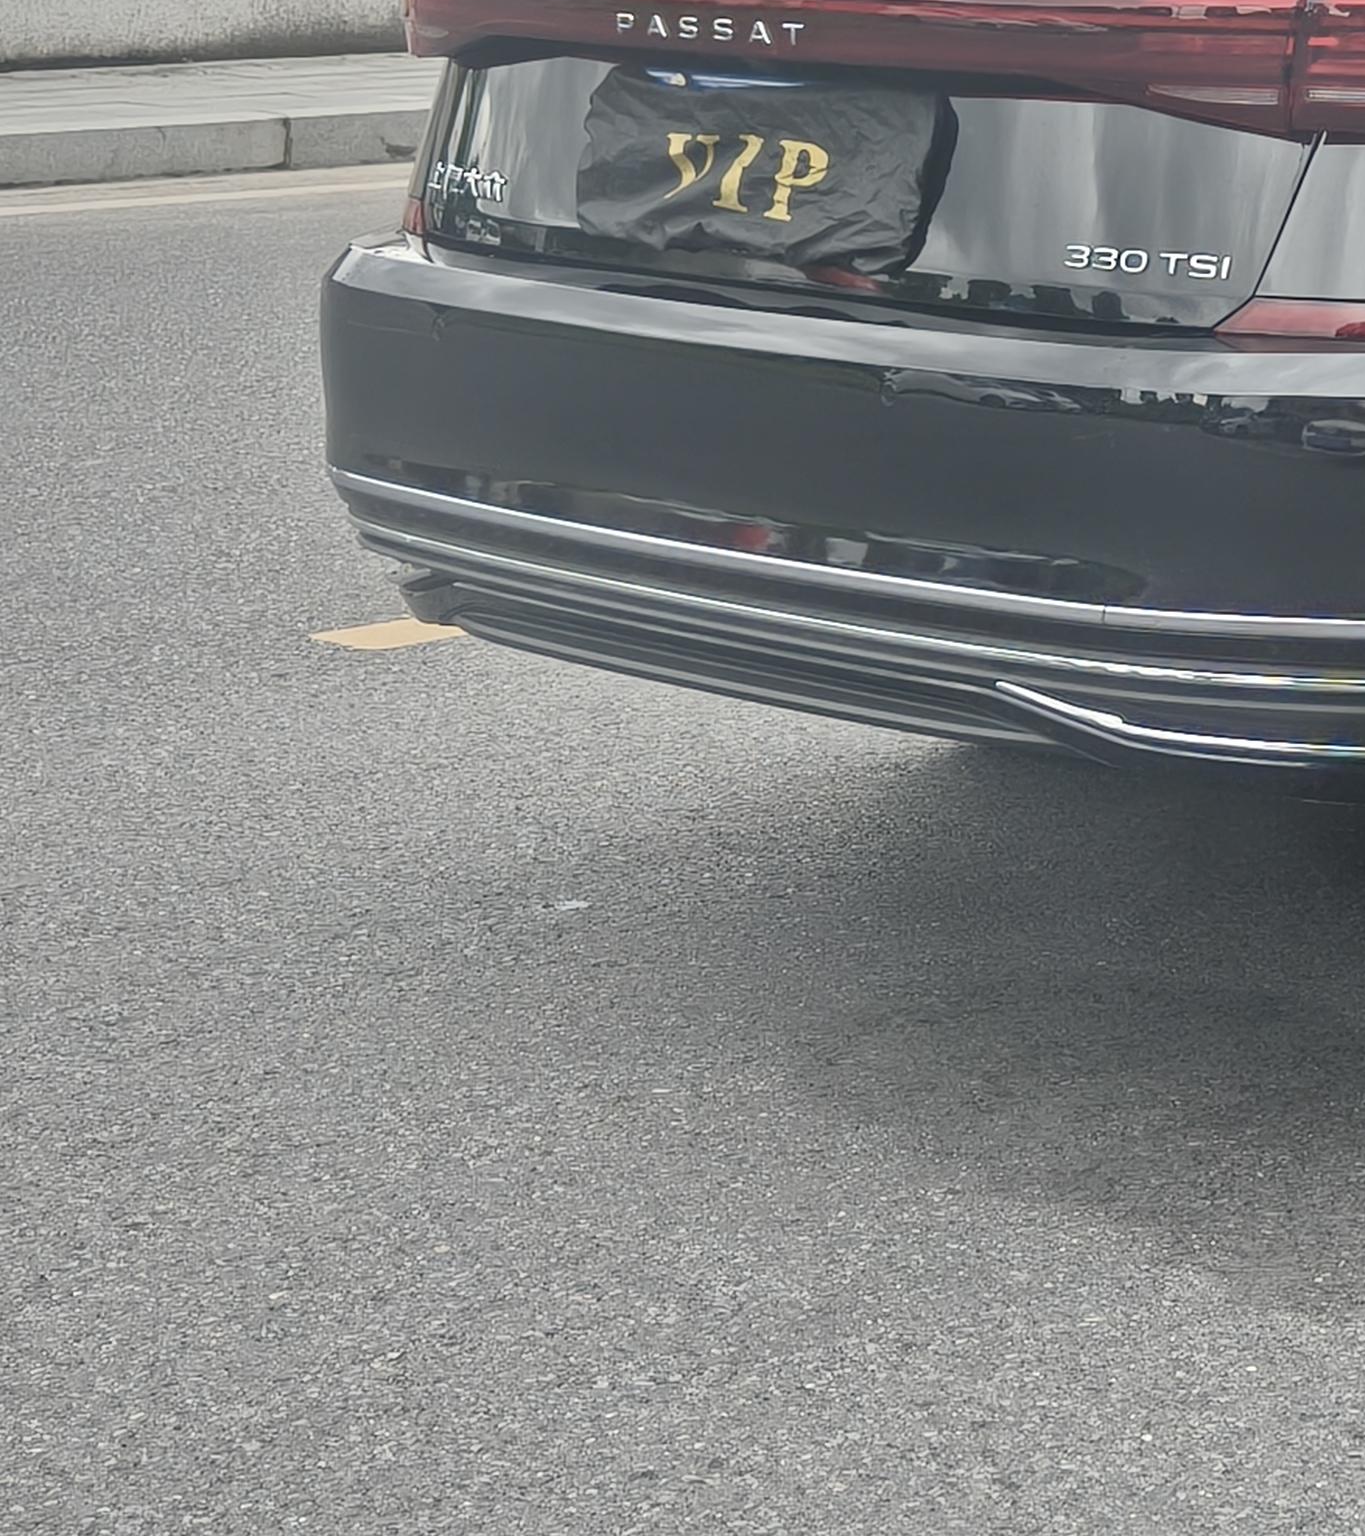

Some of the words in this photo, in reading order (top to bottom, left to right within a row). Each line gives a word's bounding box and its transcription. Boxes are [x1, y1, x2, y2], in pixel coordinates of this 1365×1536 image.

[615, 12, 805, 46] PASSAT
[662, 131, 830, 223] VIP
[1063, 244, 1149, 274] 330
[1159, 251, 1232, 280] TSI
